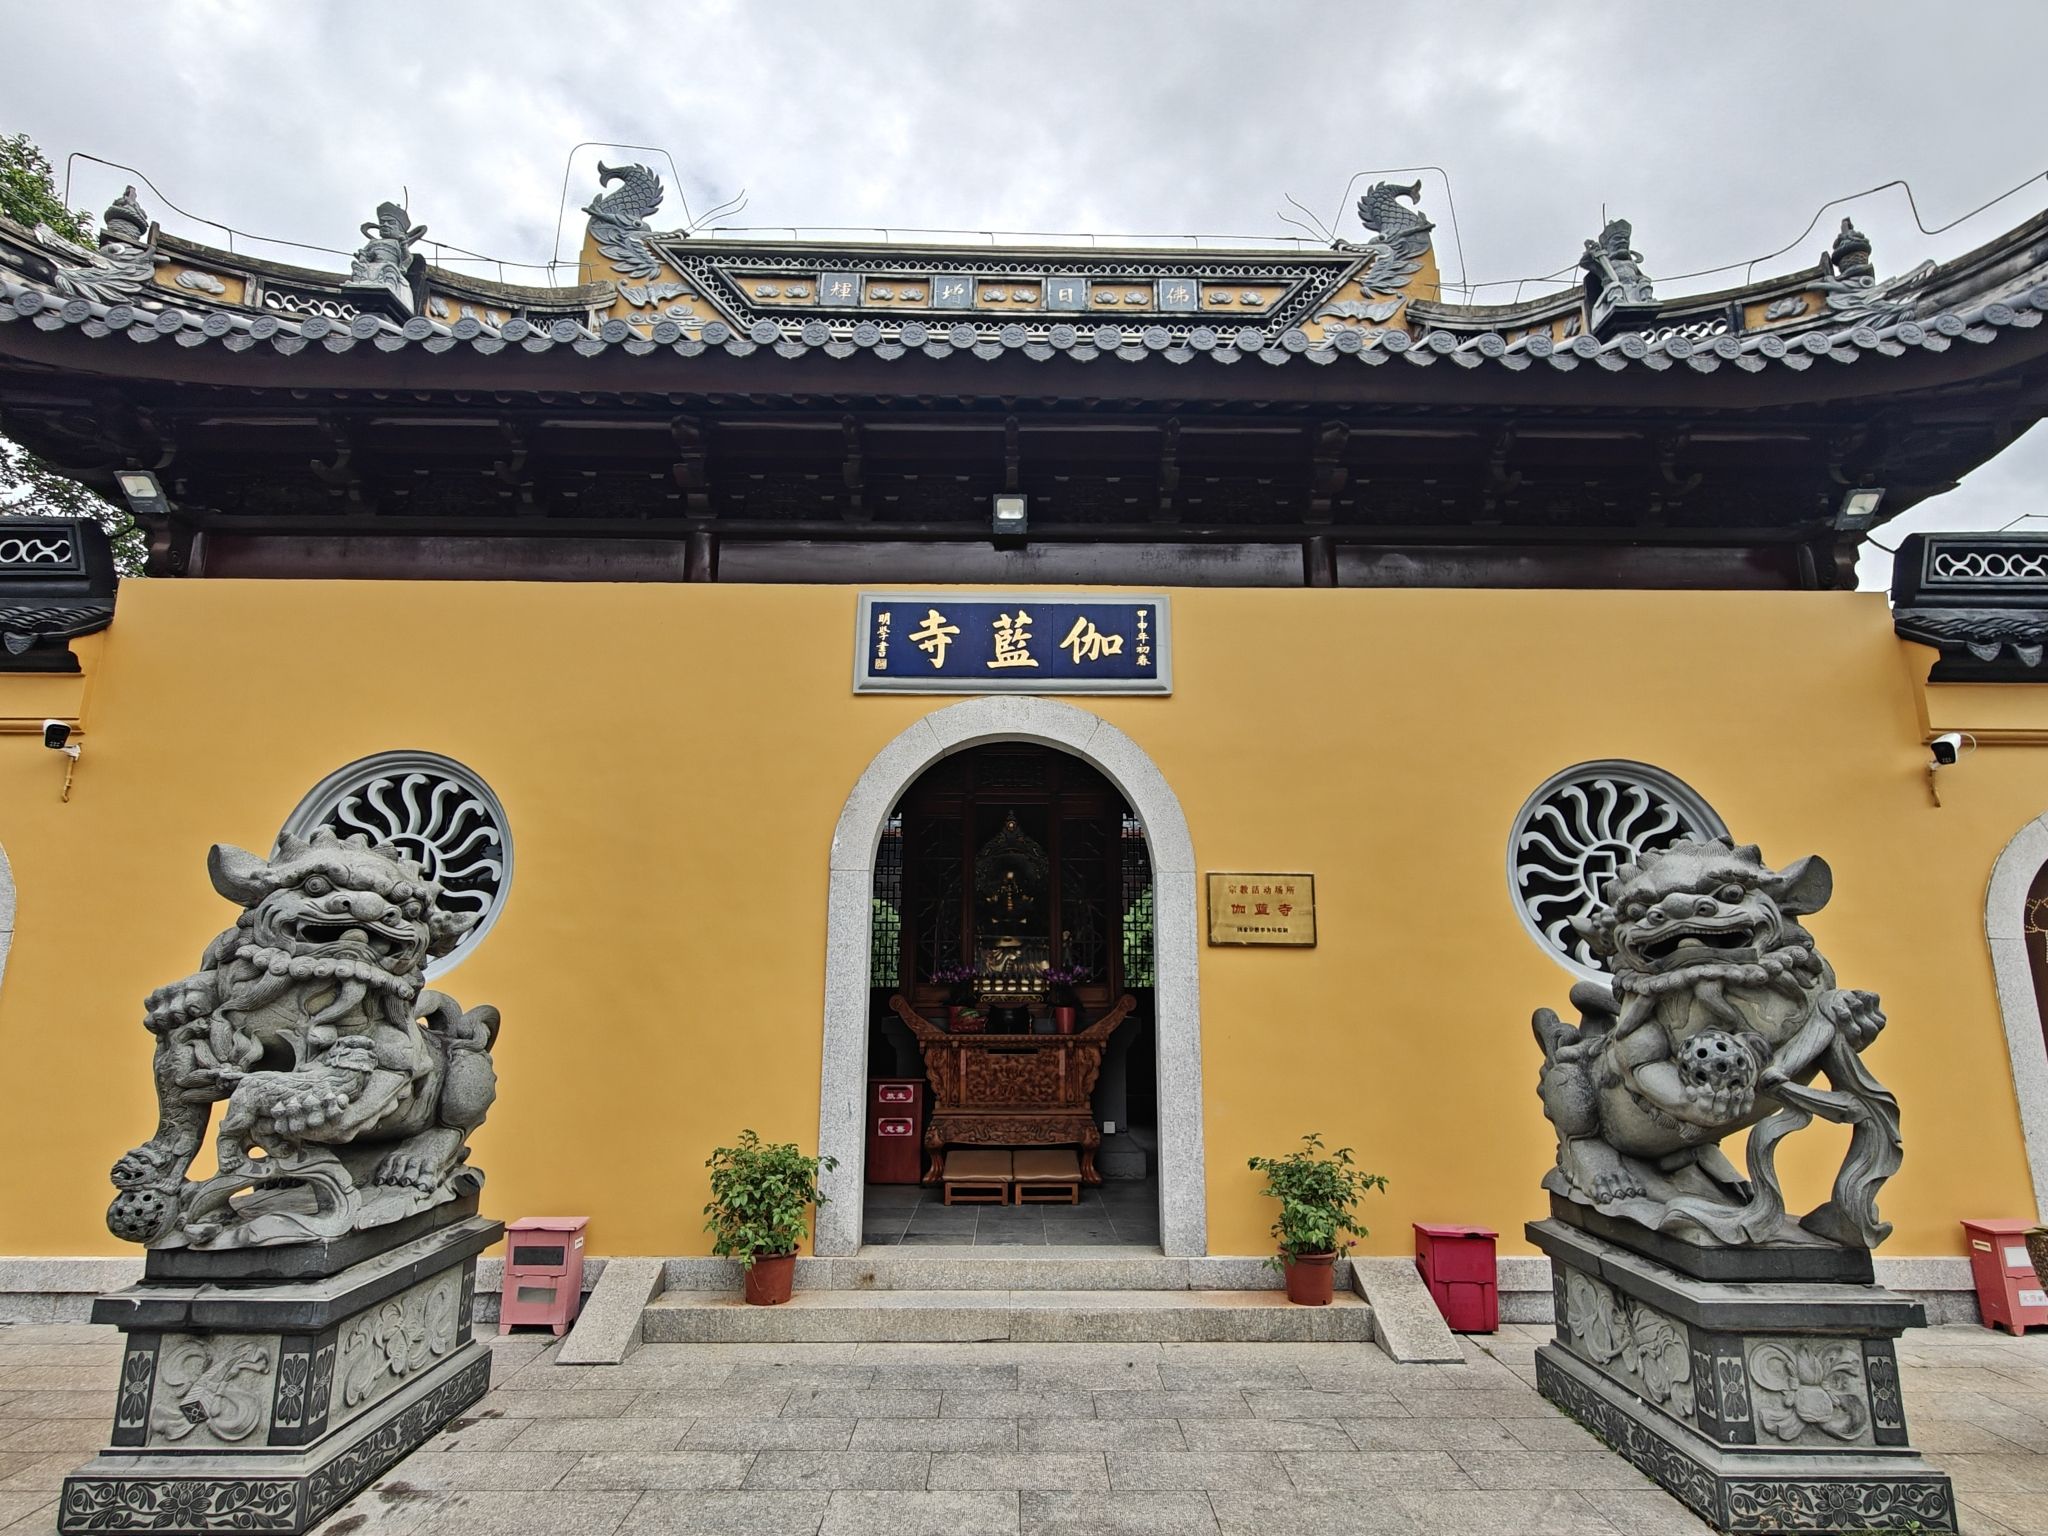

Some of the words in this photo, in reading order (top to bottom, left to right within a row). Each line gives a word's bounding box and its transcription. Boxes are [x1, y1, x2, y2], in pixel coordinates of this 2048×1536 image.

[908, 609, 1123, 669] 伽藍寺
[1228, 884, 1295, 895] 宗教活动场所
